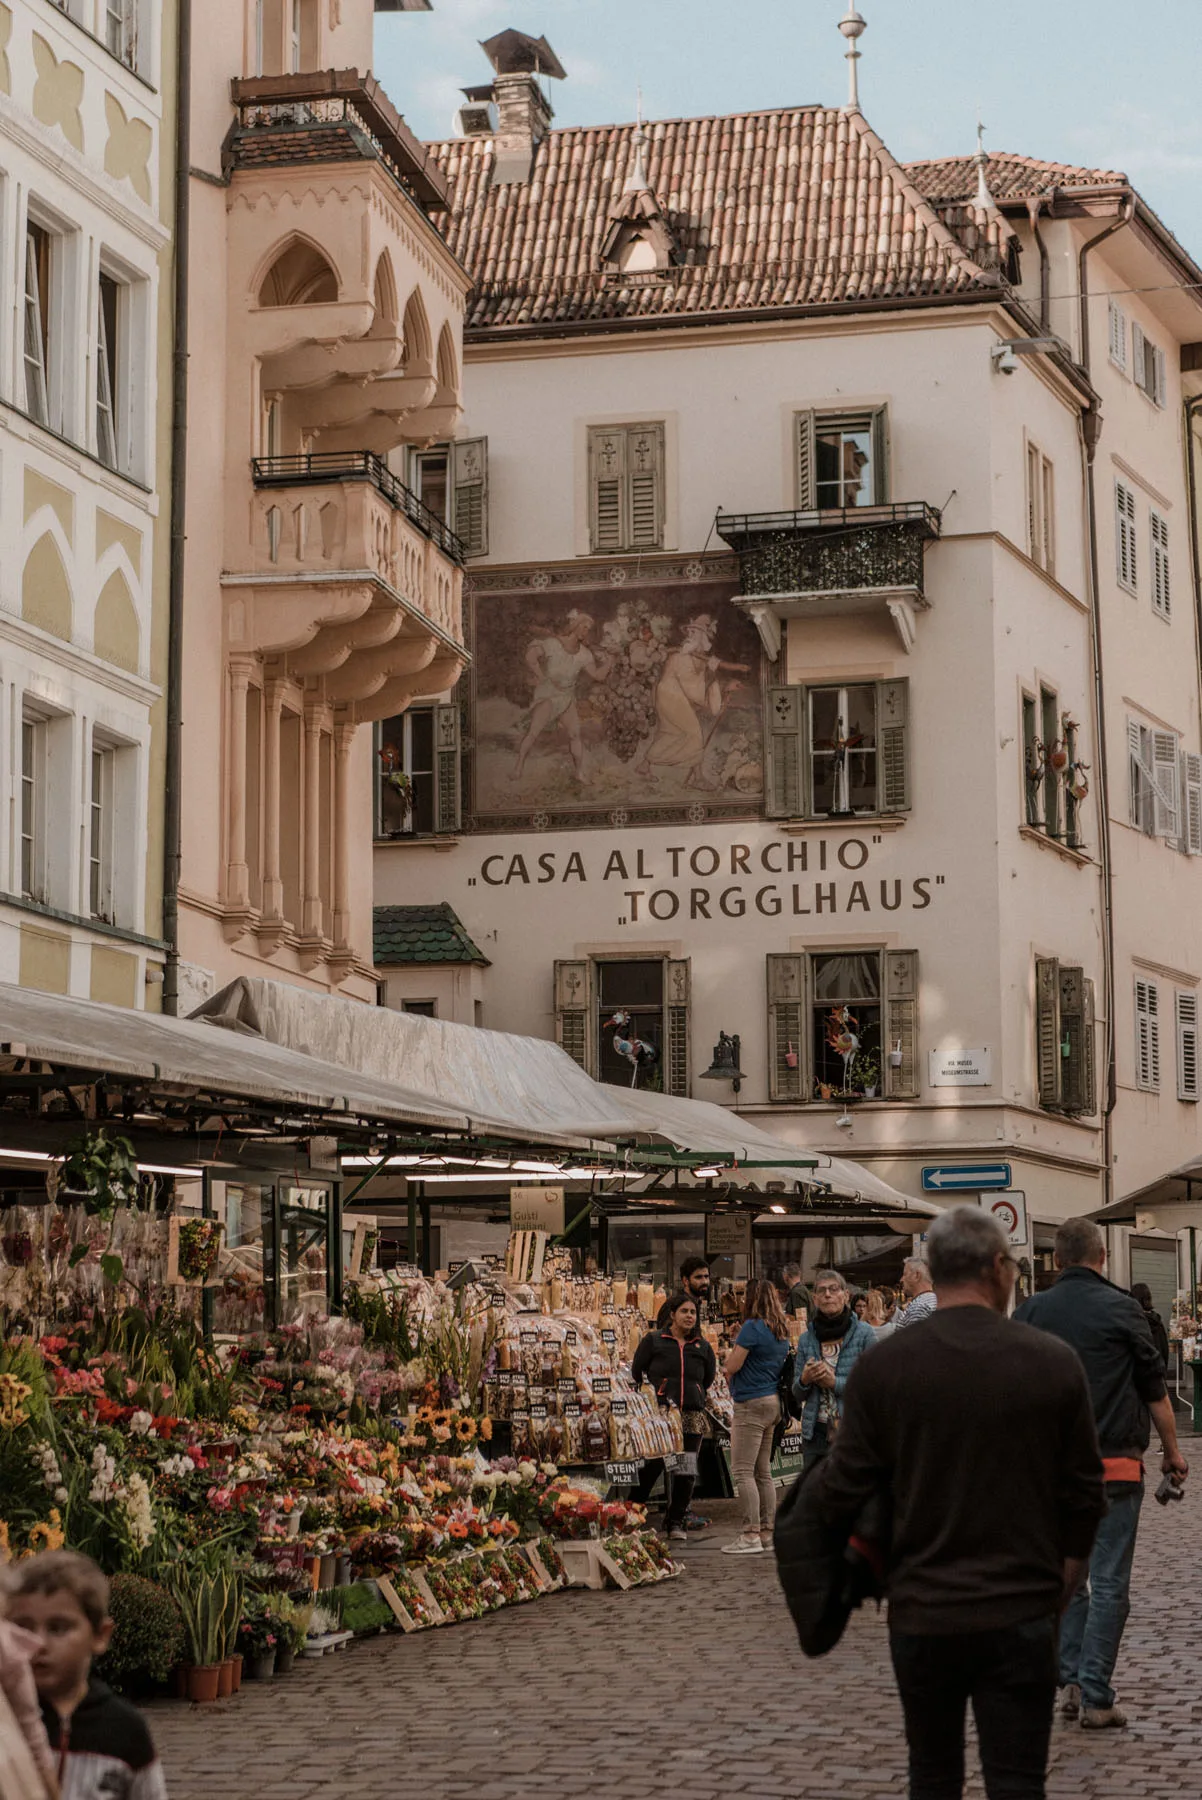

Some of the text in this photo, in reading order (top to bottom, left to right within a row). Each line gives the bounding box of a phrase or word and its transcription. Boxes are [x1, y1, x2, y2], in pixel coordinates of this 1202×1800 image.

[602, 849, 654, 881] AL
[513, 1211, 538, 1221] Gusti
[781, 1435, 803, 1447] STEIN
[607, 1463, 636, 1474] STEIN
[612, 1474, 632, 1483] PILZE
